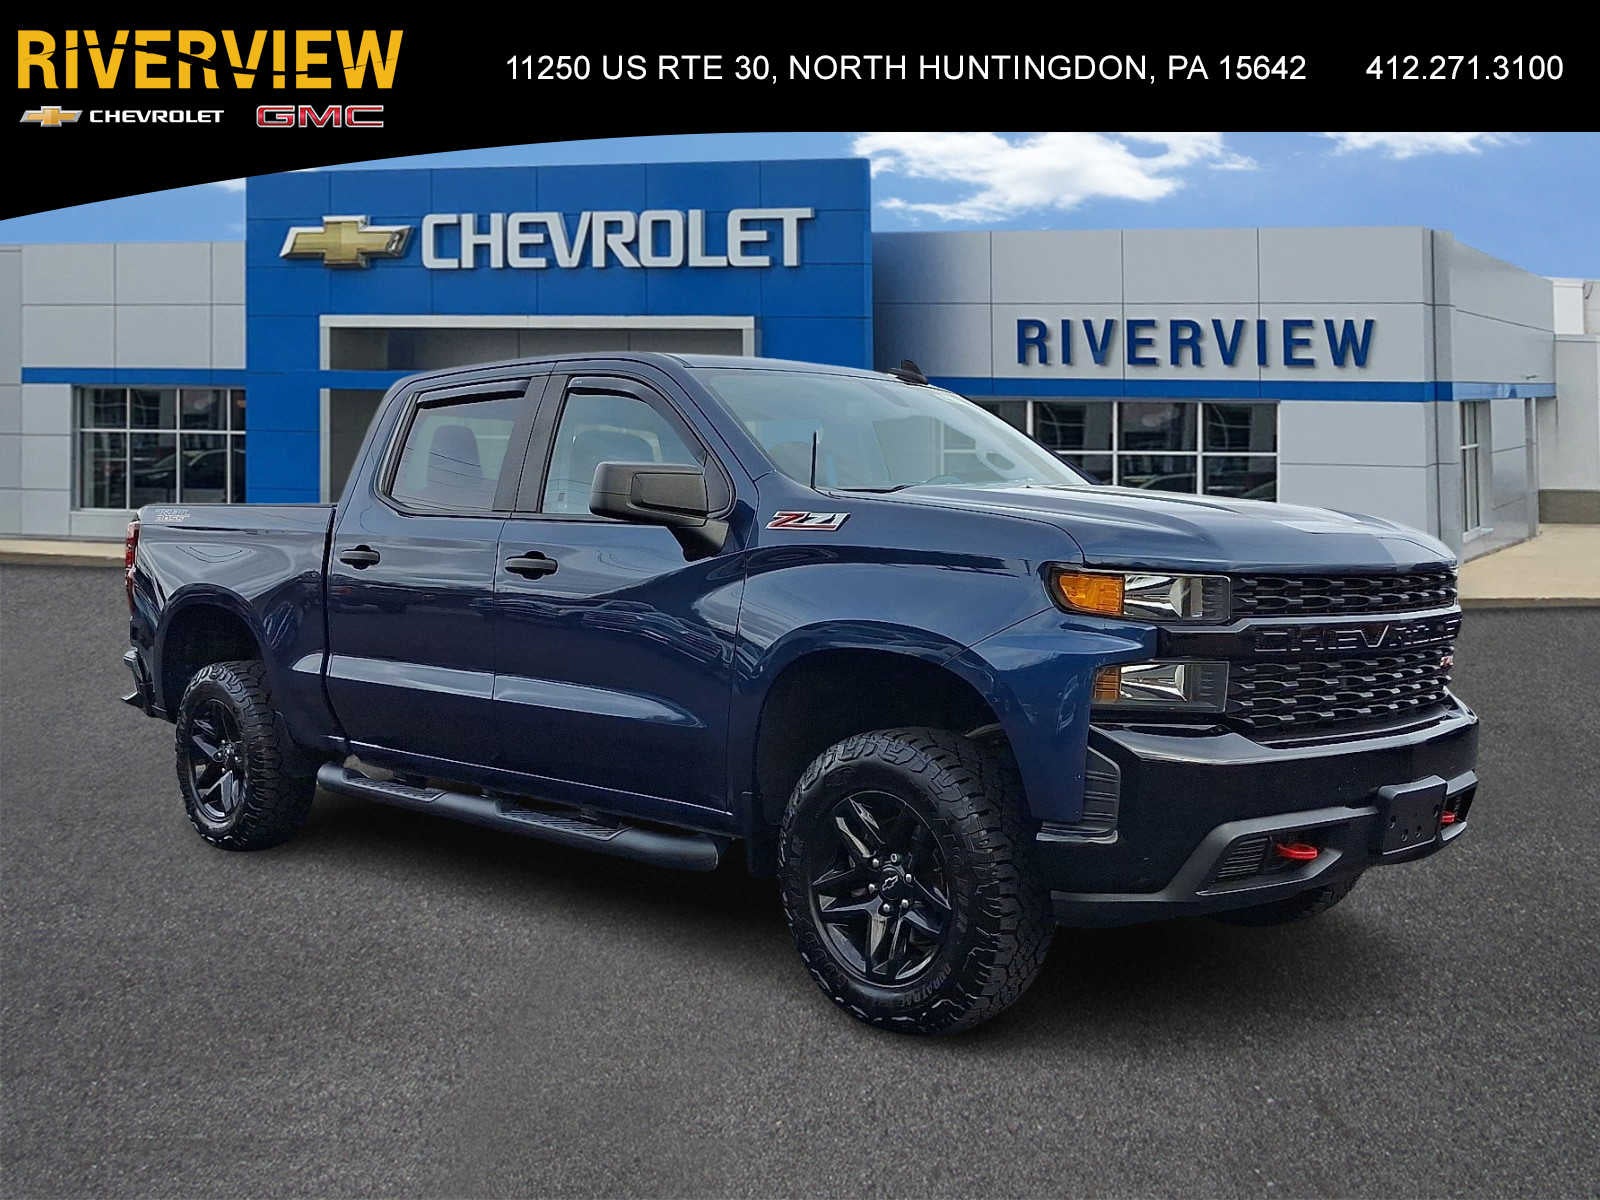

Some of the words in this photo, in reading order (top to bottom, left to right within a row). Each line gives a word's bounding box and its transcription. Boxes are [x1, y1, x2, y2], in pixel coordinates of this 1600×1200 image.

[421, 207, 814, 270] CHEVROLET
[1016, 319, 1375, 367] RIVERVIEW
[765, 511, 851, 532] Z71
